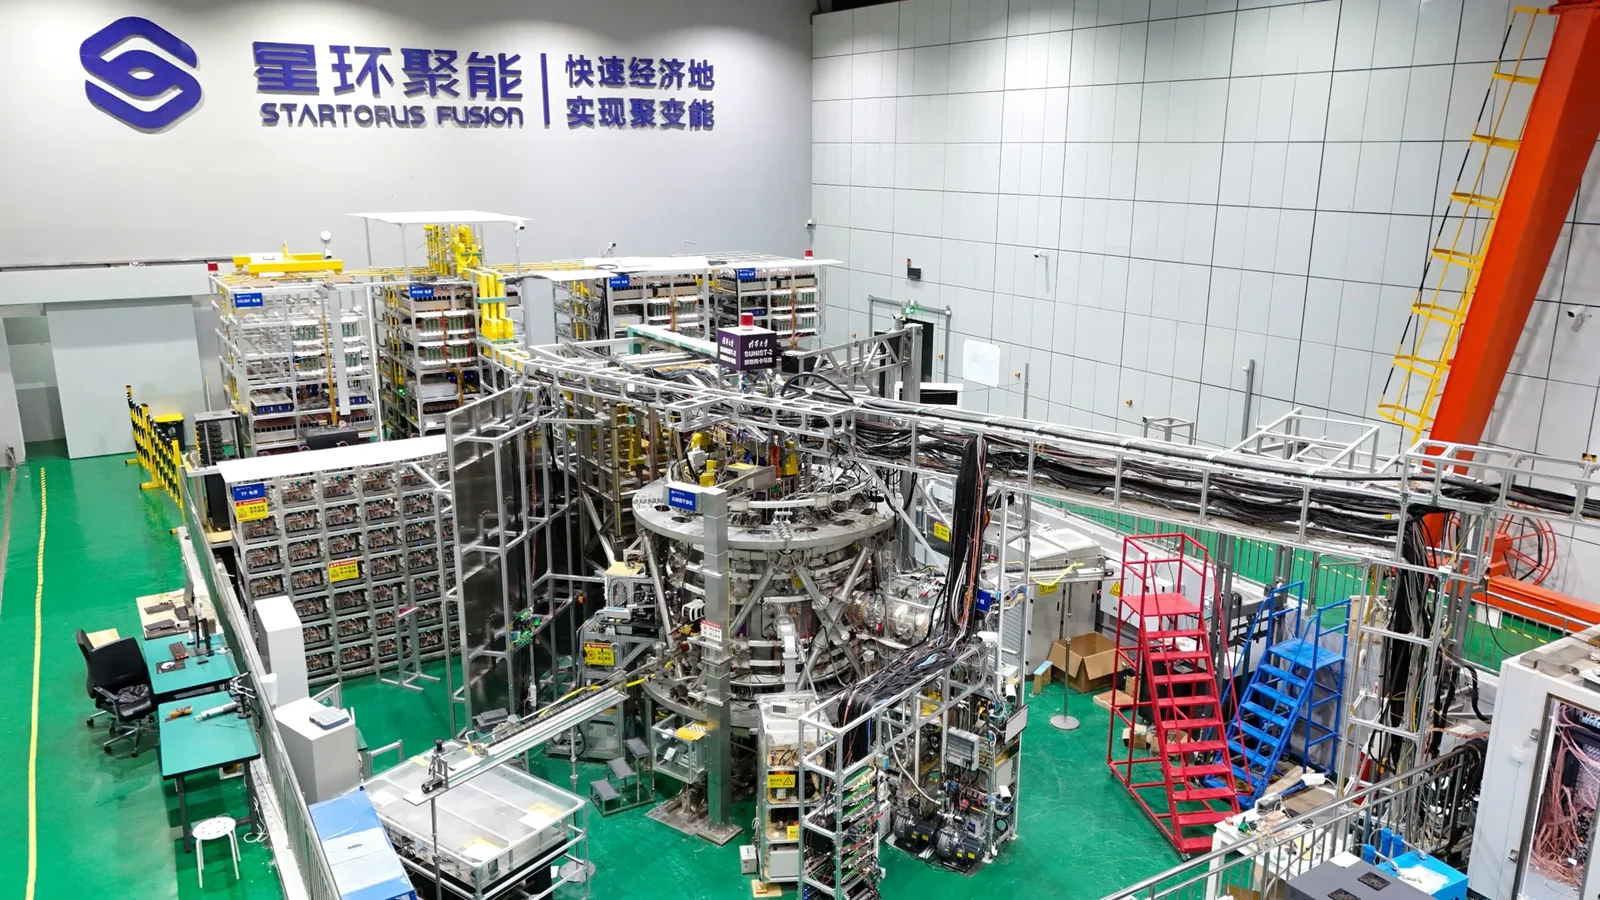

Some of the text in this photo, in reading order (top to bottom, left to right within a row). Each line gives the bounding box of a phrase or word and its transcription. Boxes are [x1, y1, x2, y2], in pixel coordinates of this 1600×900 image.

[252, 41, 523, 99] 星环聚能
[565, 54, 715, 90] 快速经济地
[260, 103, 524, 128] STARTORUS FUSION
[566, 96, 715, 130] 实现聚变能
[744, 349, 773, 358] SUNIST-2
